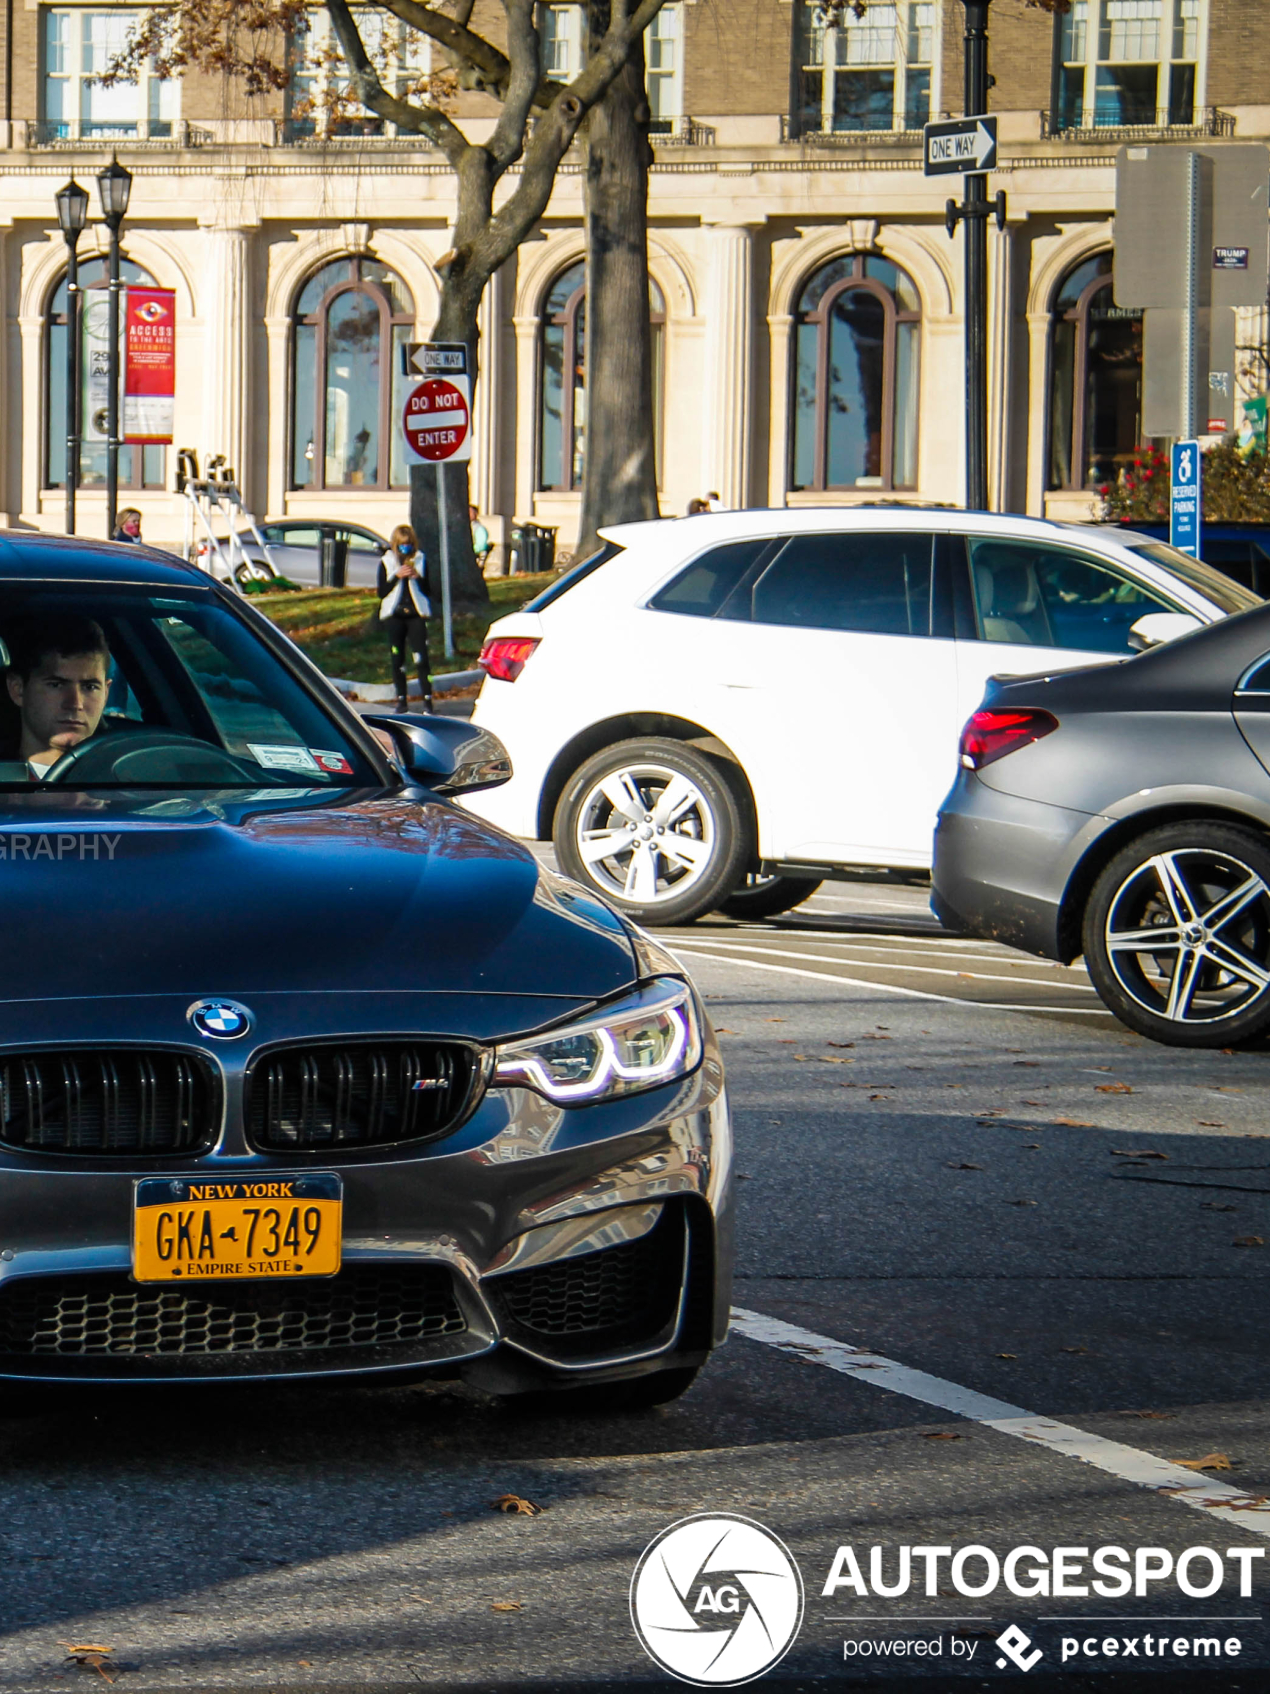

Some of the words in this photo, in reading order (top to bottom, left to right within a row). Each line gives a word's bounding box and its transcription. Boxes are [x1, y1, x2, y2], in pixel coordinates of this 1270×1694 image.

[931, 138, 951, 159] ONE
[955, 135, 976, 156] WAY
[1215, 249, 1246, 257] TRUMP
[130, 325, 172, 336] ACCESS
[424, 353, 441, 365] ONE
[443, 353, 460, 365] WAY
[411, 396, 429, 410] DO
[435, 393, 458, 408] NOT
[417, 430, 457, 446] ENTER
[1172, 485, 1196, 498] RESERVED
[1174, 500, 1195, 513] PARKING
[189, 1184, 237, 1200] NEW
[242, 1182, 294, 1198] YORK
[187, 1262, 243, 1275] EMPIRE
[247, 1260, 291, 1273] STATE
